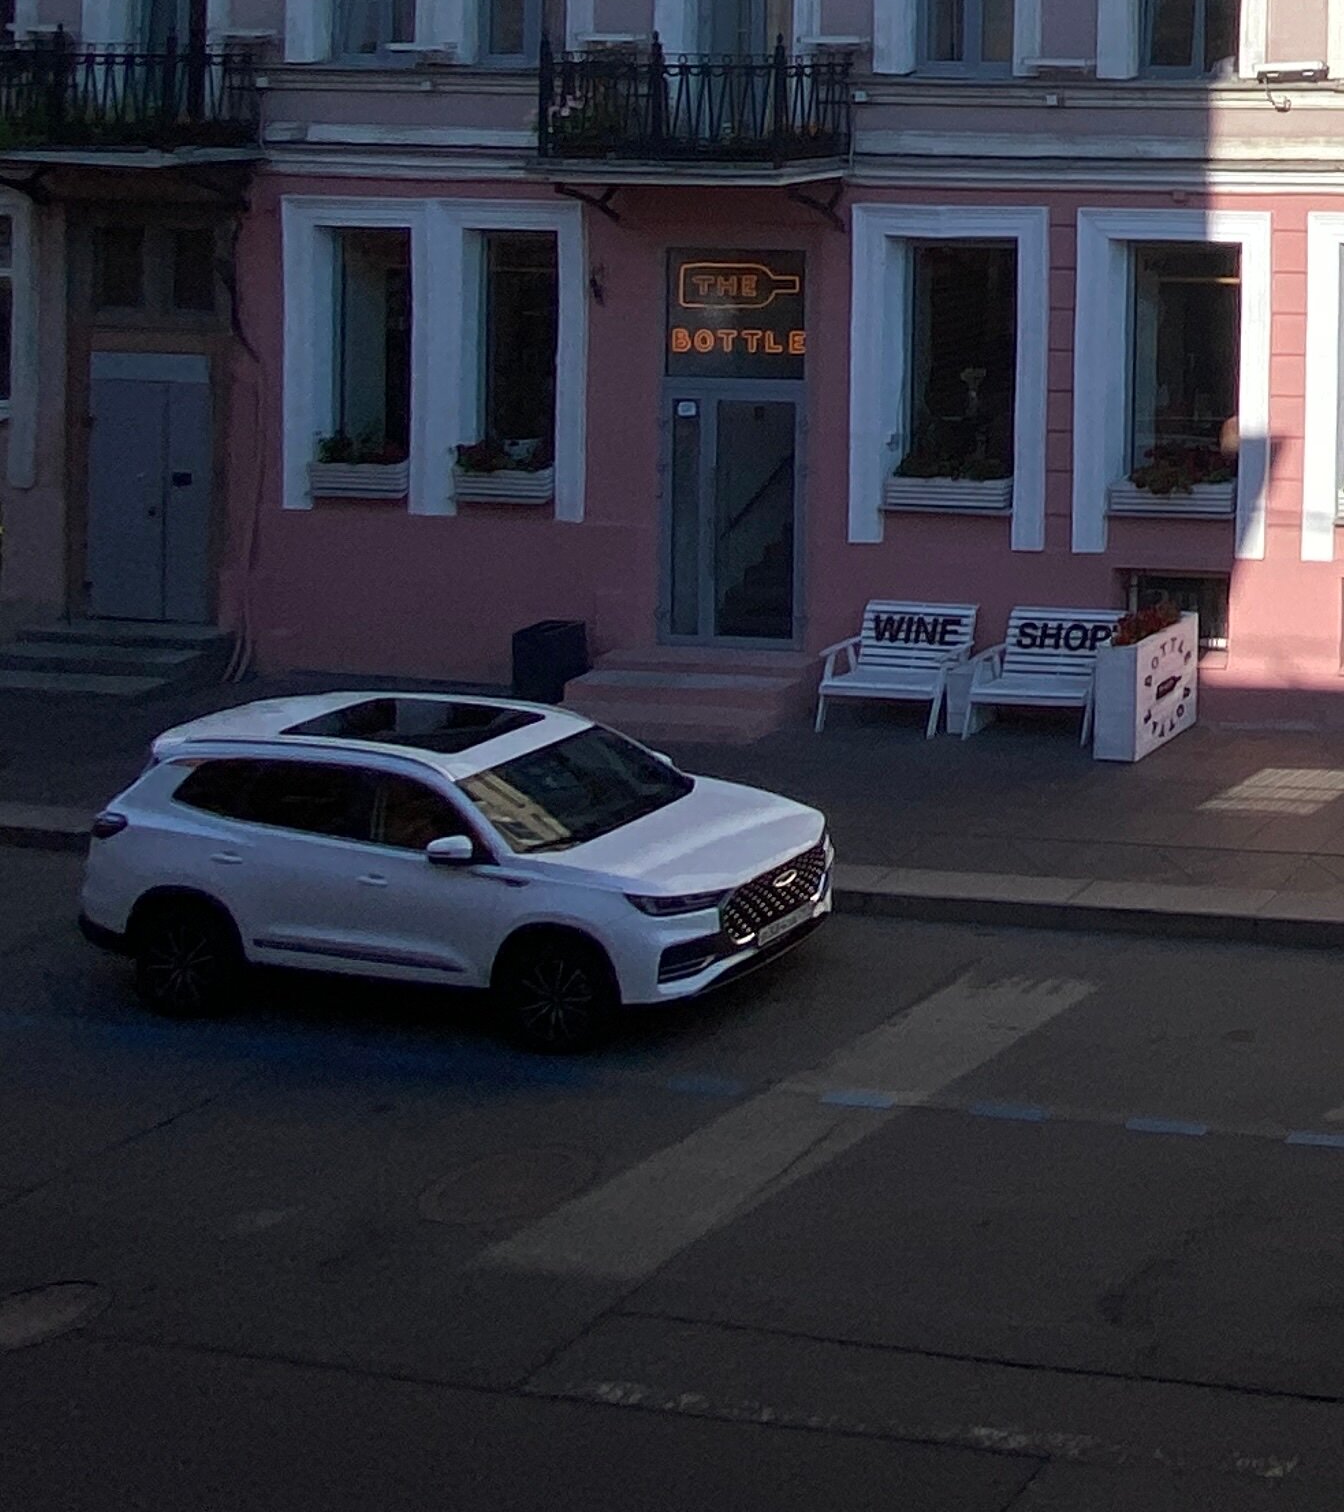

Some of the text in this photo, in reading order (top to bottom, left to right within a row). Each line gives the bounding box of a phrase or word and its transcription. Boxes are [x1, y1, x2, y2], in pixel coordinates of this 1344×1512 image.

[692, 274, 758, 297] THE
[671, 327, 807, 355] BOTTLE
[874, 614, 962, 646] WINE
[1016, 621, 1112, 651] SHOP
